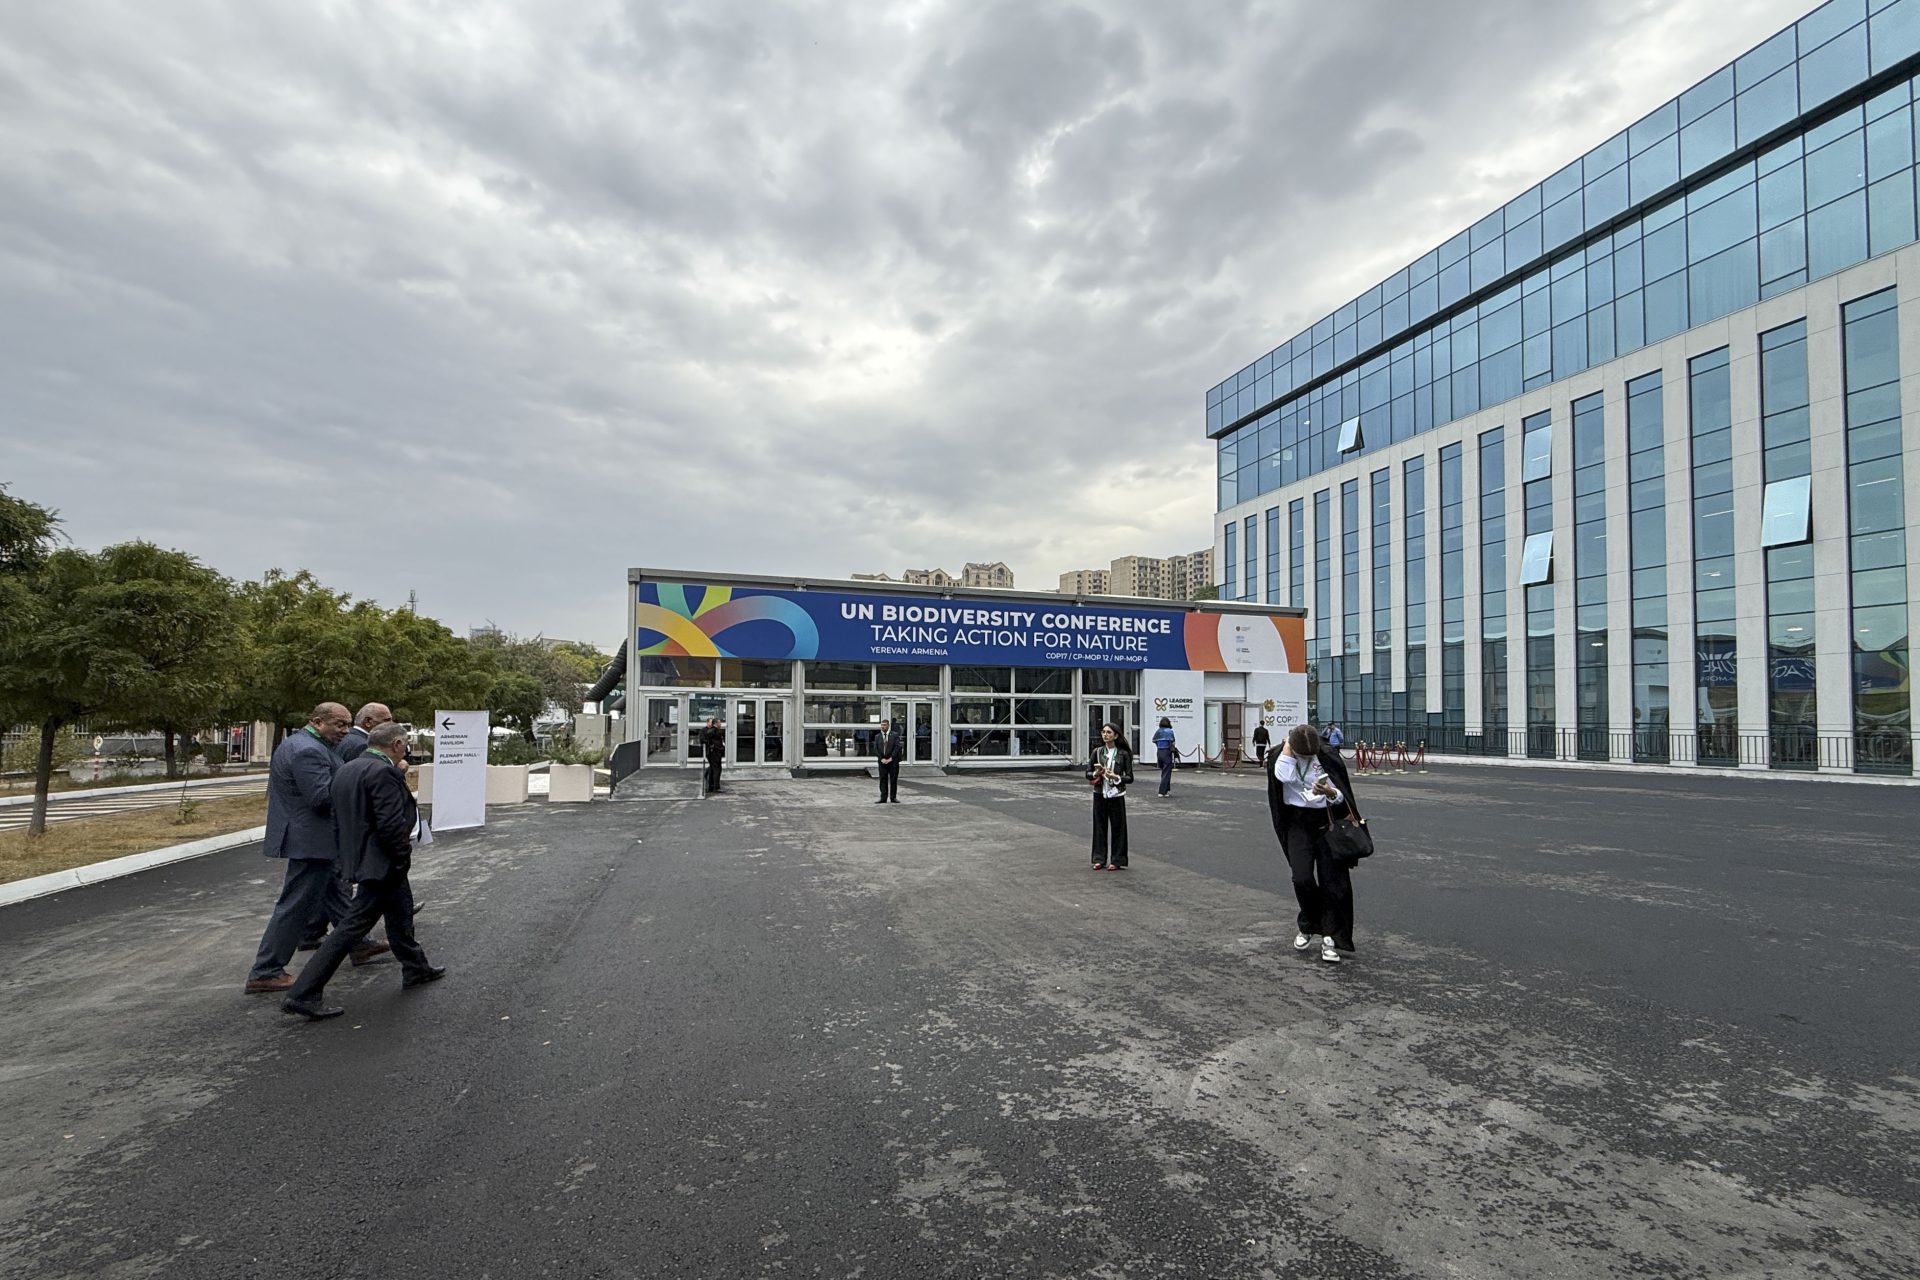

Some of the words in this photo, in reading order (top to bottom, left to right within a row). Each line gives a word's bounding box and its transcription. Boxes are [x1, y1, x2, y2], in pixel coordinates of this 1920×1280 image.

[841, 603, 874, 620] UN
[882, 605, 1036, 627] BIODIVERSITY
[1041, 613, 1171, 634] CONFERENCE
[870, 625, 948, 644] TAKING
[953, 629, 1027, 647] ACTION
[1033, 632, 1071, 648] FOR
[1077, 634, 1148, 651] NATURE
[870, 646, 908, 654] YEREVAN
[911, 648, 948, 656] ARMENIA
[1046, 652, 1068, 660] COP17
[1073, 653, 1101, 661] CP-MOP
[1102, 654, 1109, 662] 12
[1114, 654, 1142, 662] NP-MOP
